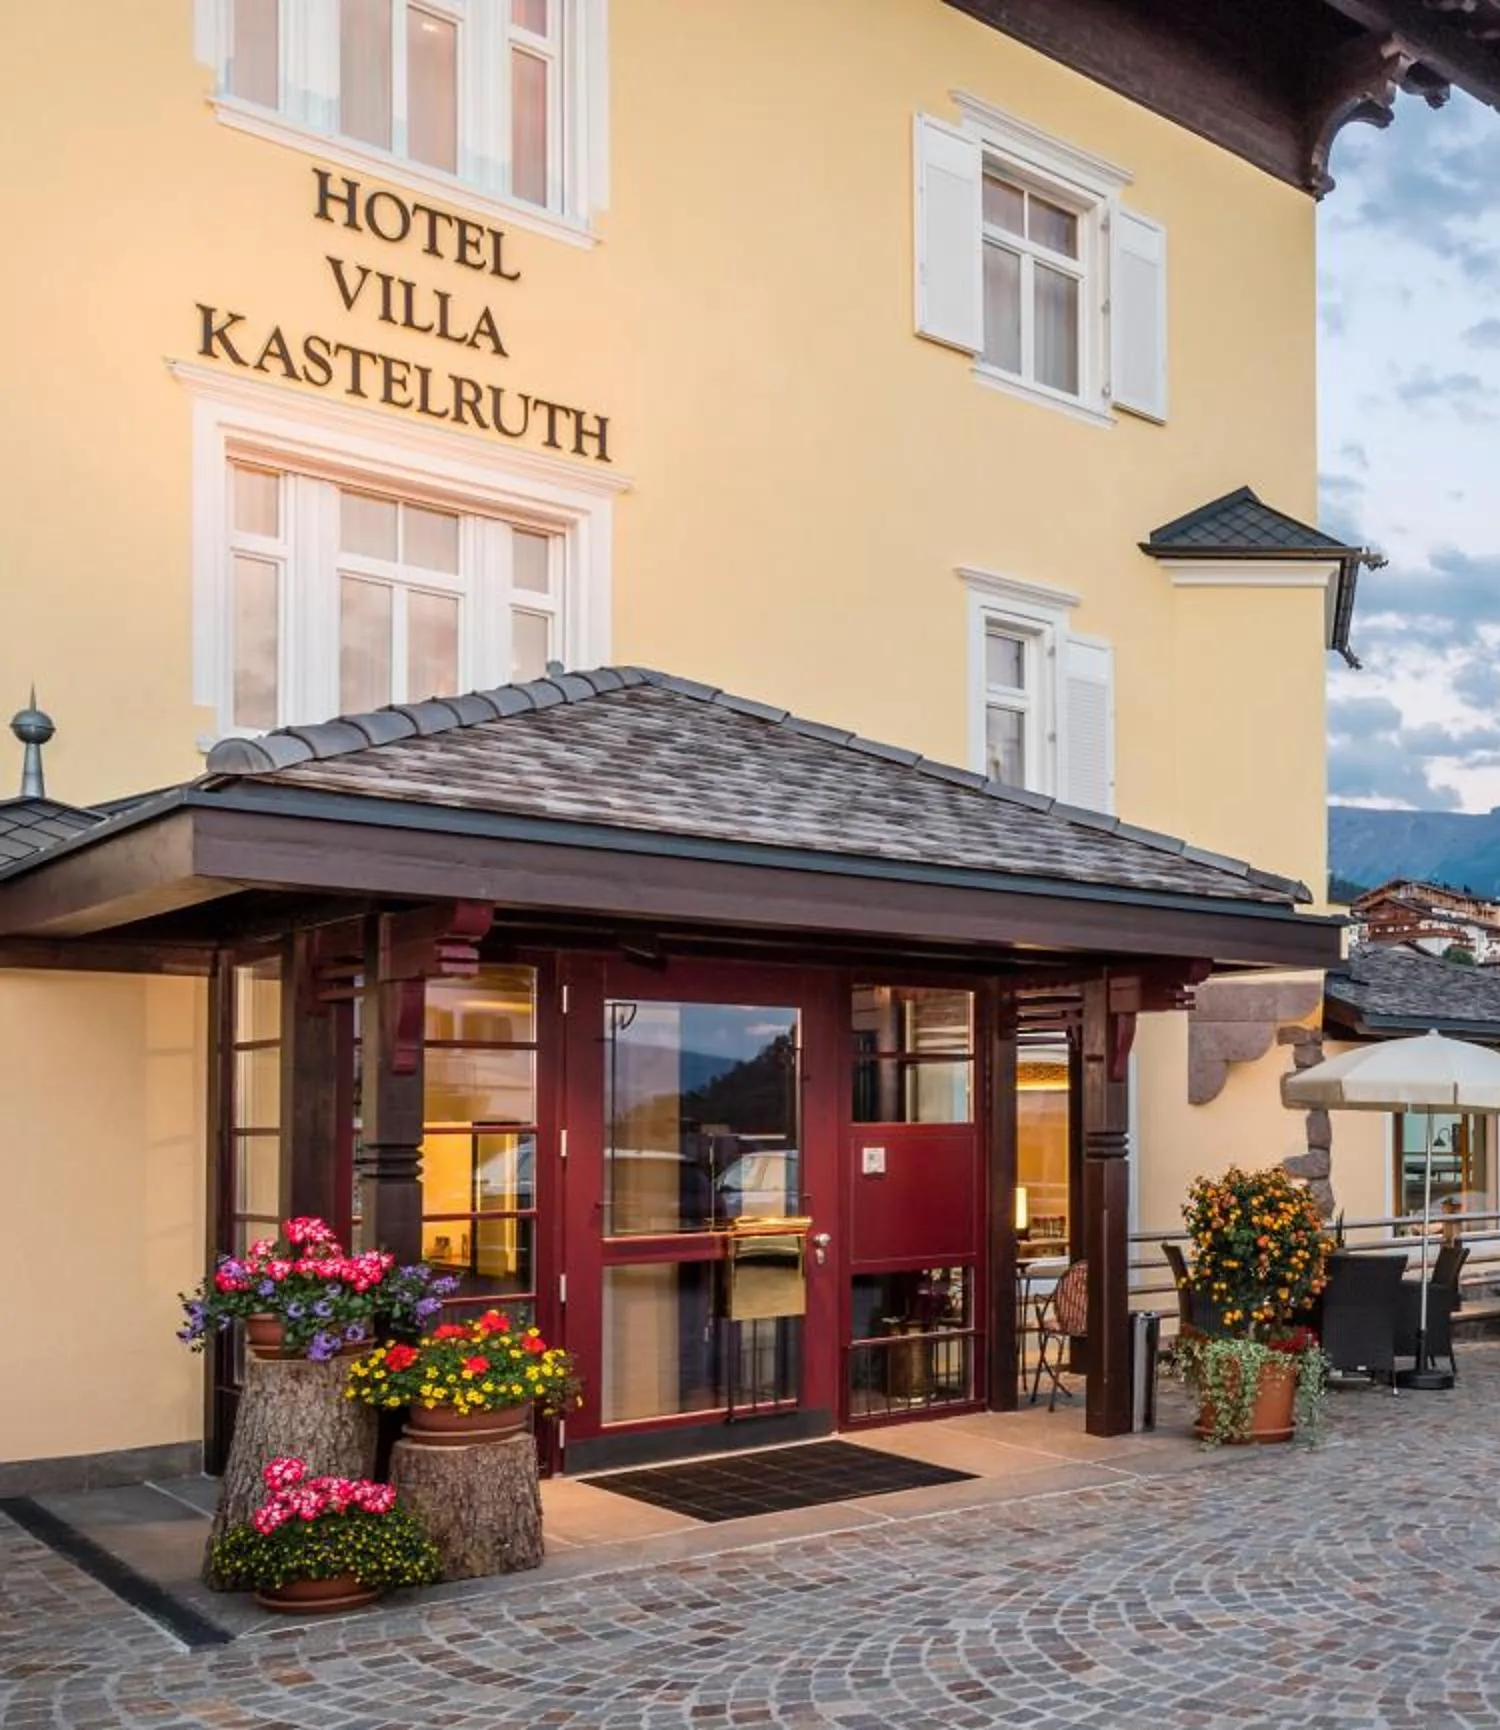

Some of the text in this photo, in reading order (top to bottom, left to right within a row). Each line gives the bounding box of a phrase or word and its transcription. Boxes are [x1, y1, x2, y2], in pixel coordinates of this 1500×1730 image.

[311, 167, 521, 281] HOTEL
[325, 255, 509, 358] VILLA
[195, 303, 612, 462] KASTELRUTH
